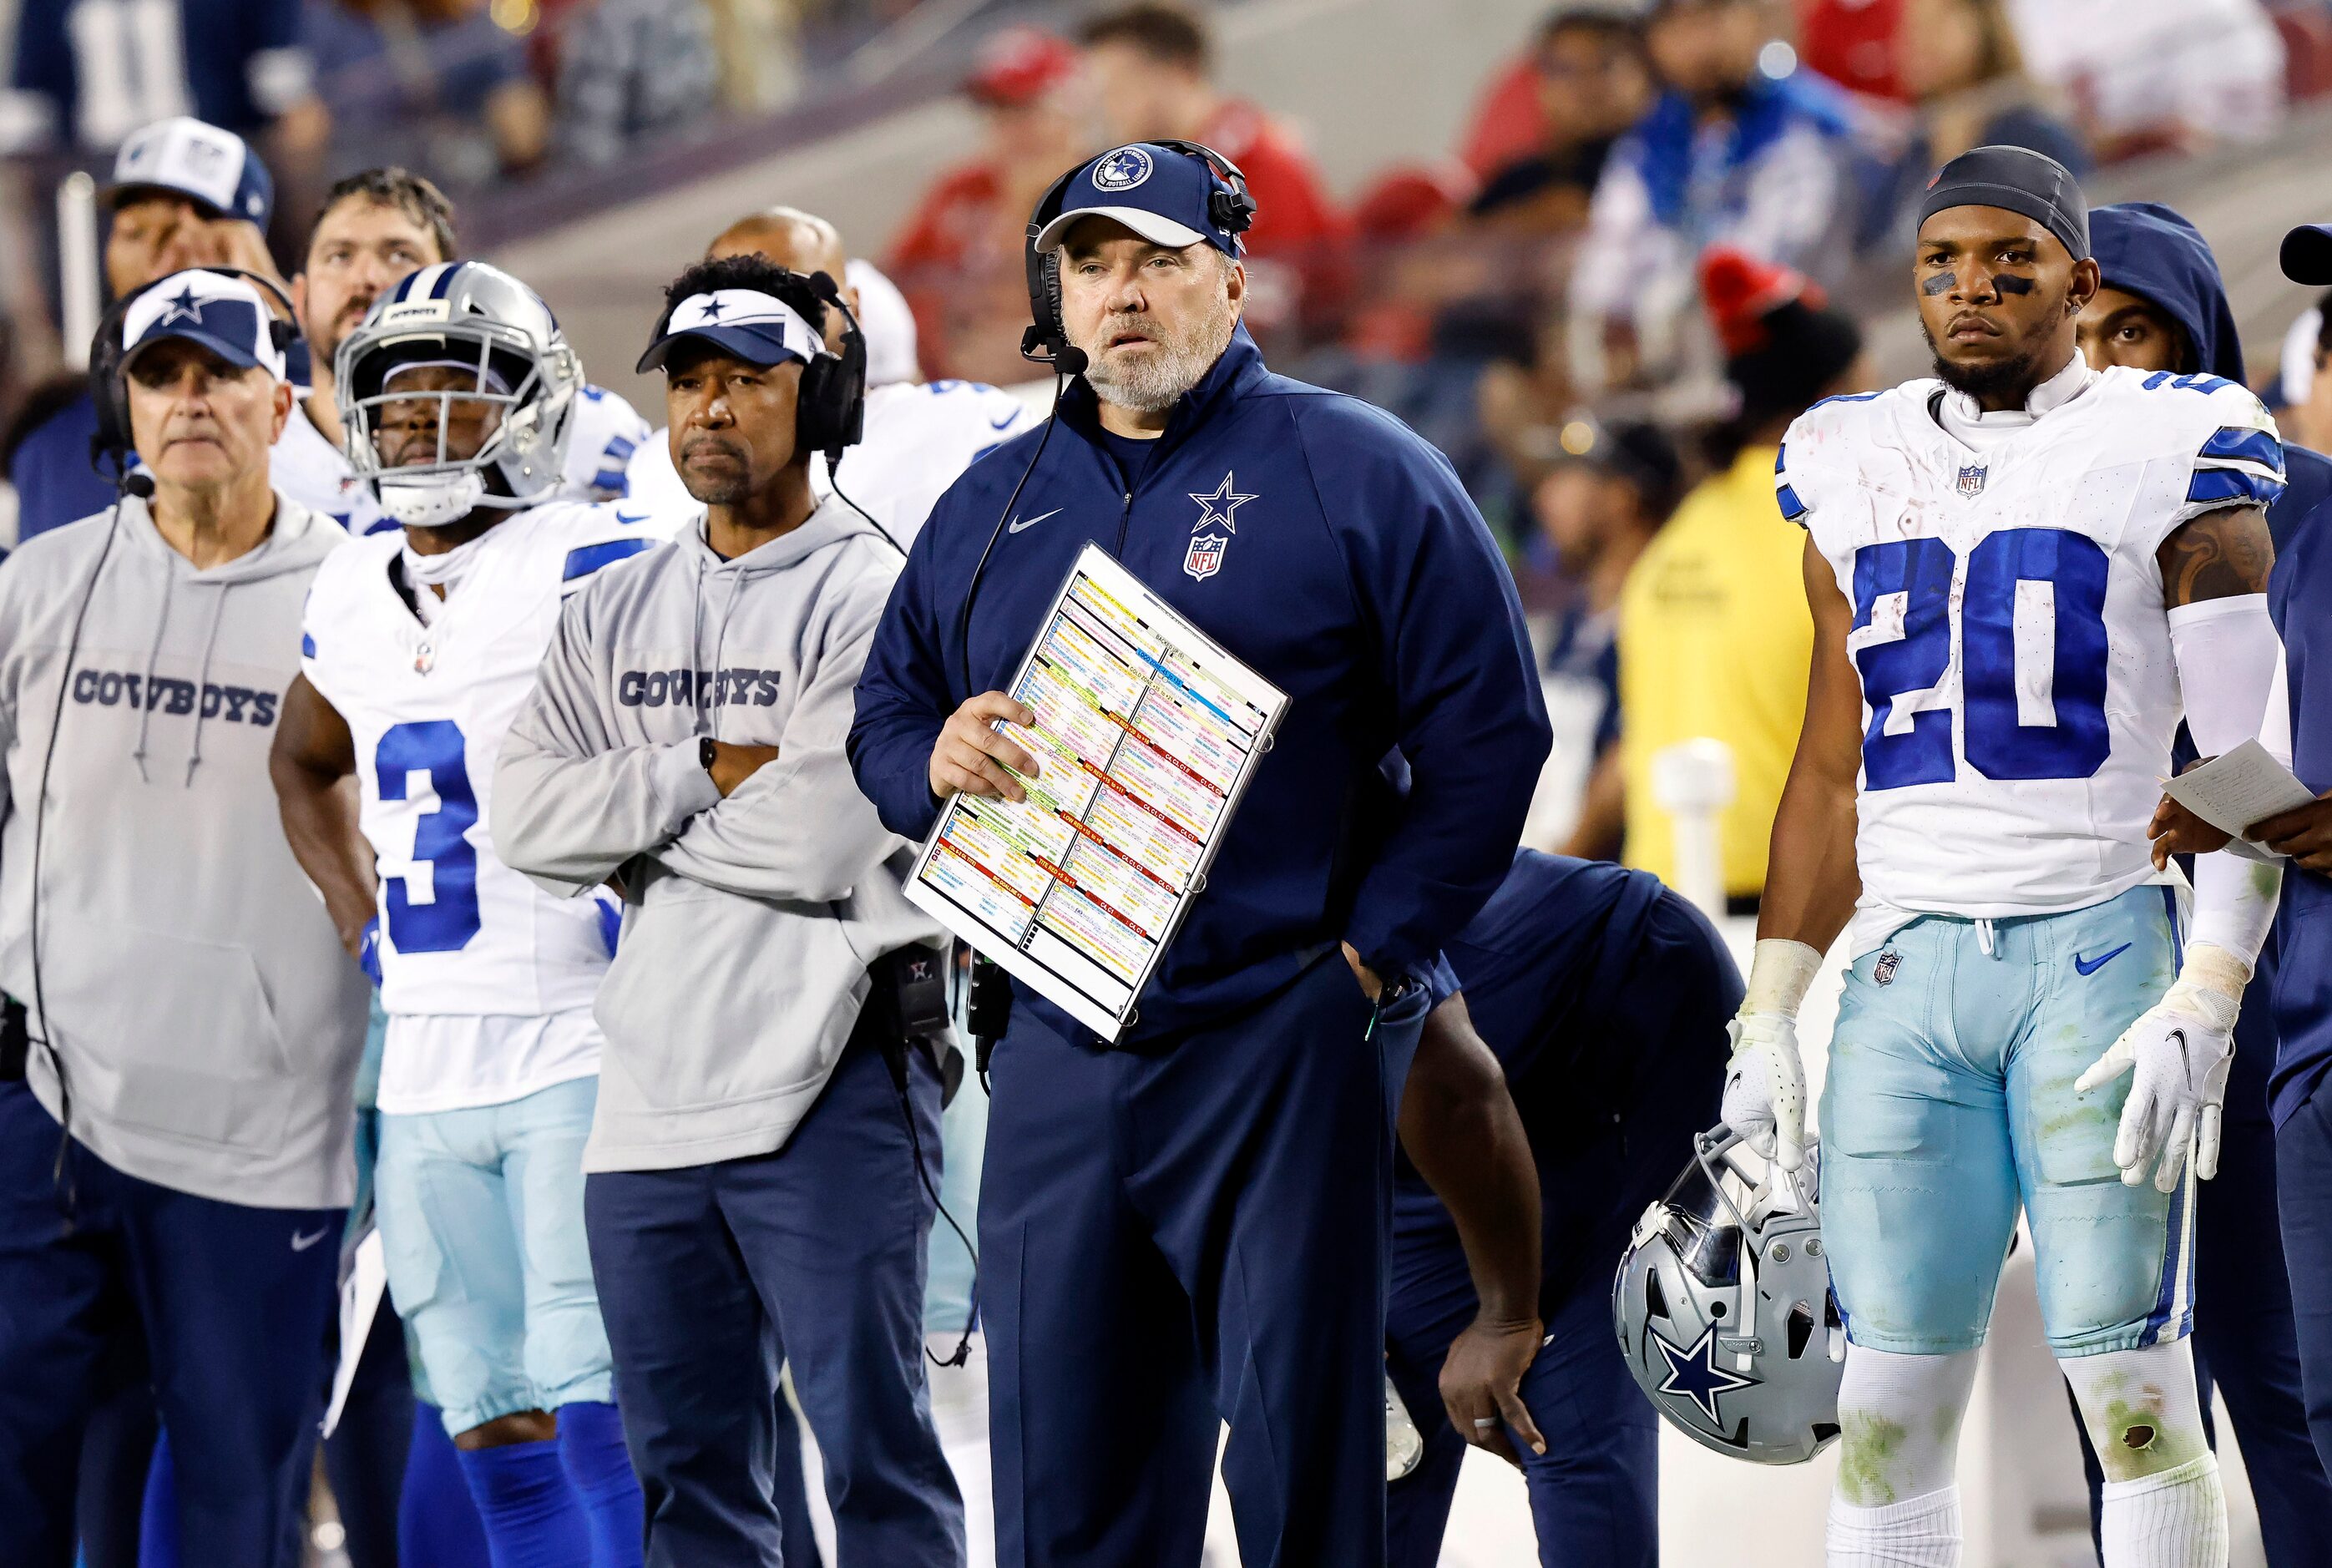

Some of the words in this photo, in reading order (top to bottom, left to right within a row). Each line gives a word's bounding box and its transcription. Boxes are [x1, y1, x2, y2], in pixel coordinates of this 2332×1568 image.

[1960, 477, 1980, 490] NFL
[1190, 552, 1215, 571] NFL
[1156, 635, 1172, 650] BACKED
[1138, 650, 1151, 661] LOGO
[1150, 659, 1162, 670] ZONE
[1848, 528, 2110, 791] 20
[1130, 667, 1141, 678] GOLD
[1141, 675, 1152, 686] ZONE
[72, 668, 279, 726] COWBOYS
[1110, 712, 1120, 723] HIGH
[1119, 718, 1129, 729] RED
[1128, 726, 1136, 735] +20
[1085, 762, 1094, 772] MID
[1093, 768, 1103, 778] RED
[1102, 775, 1110, 784] +15
[1115, 784, 1124, 793] +11
[1143, 804, 1151, 812] C4,
[1151, 809, 1159, 817] C1,
[1063, 813, 1073, 824] LOW
[1073, 821, 1083, 831] RED
[1082, 827, 1090, 836] +10
[1180, 828, 1188, 837] C4,
[375, 719, 482, 954] 3
[1039, 859, 1049, 869] TITE
[1048, 864, 1058, 875] RED
[1121, 854, 1130, 863] C4,
[1129, 859, 1137, 868] C1,
[1100, 902, 1108, 911] C4,
[1129, 922, 1137, 930] C4,
[1875, 964, 1893, 980] NFL
